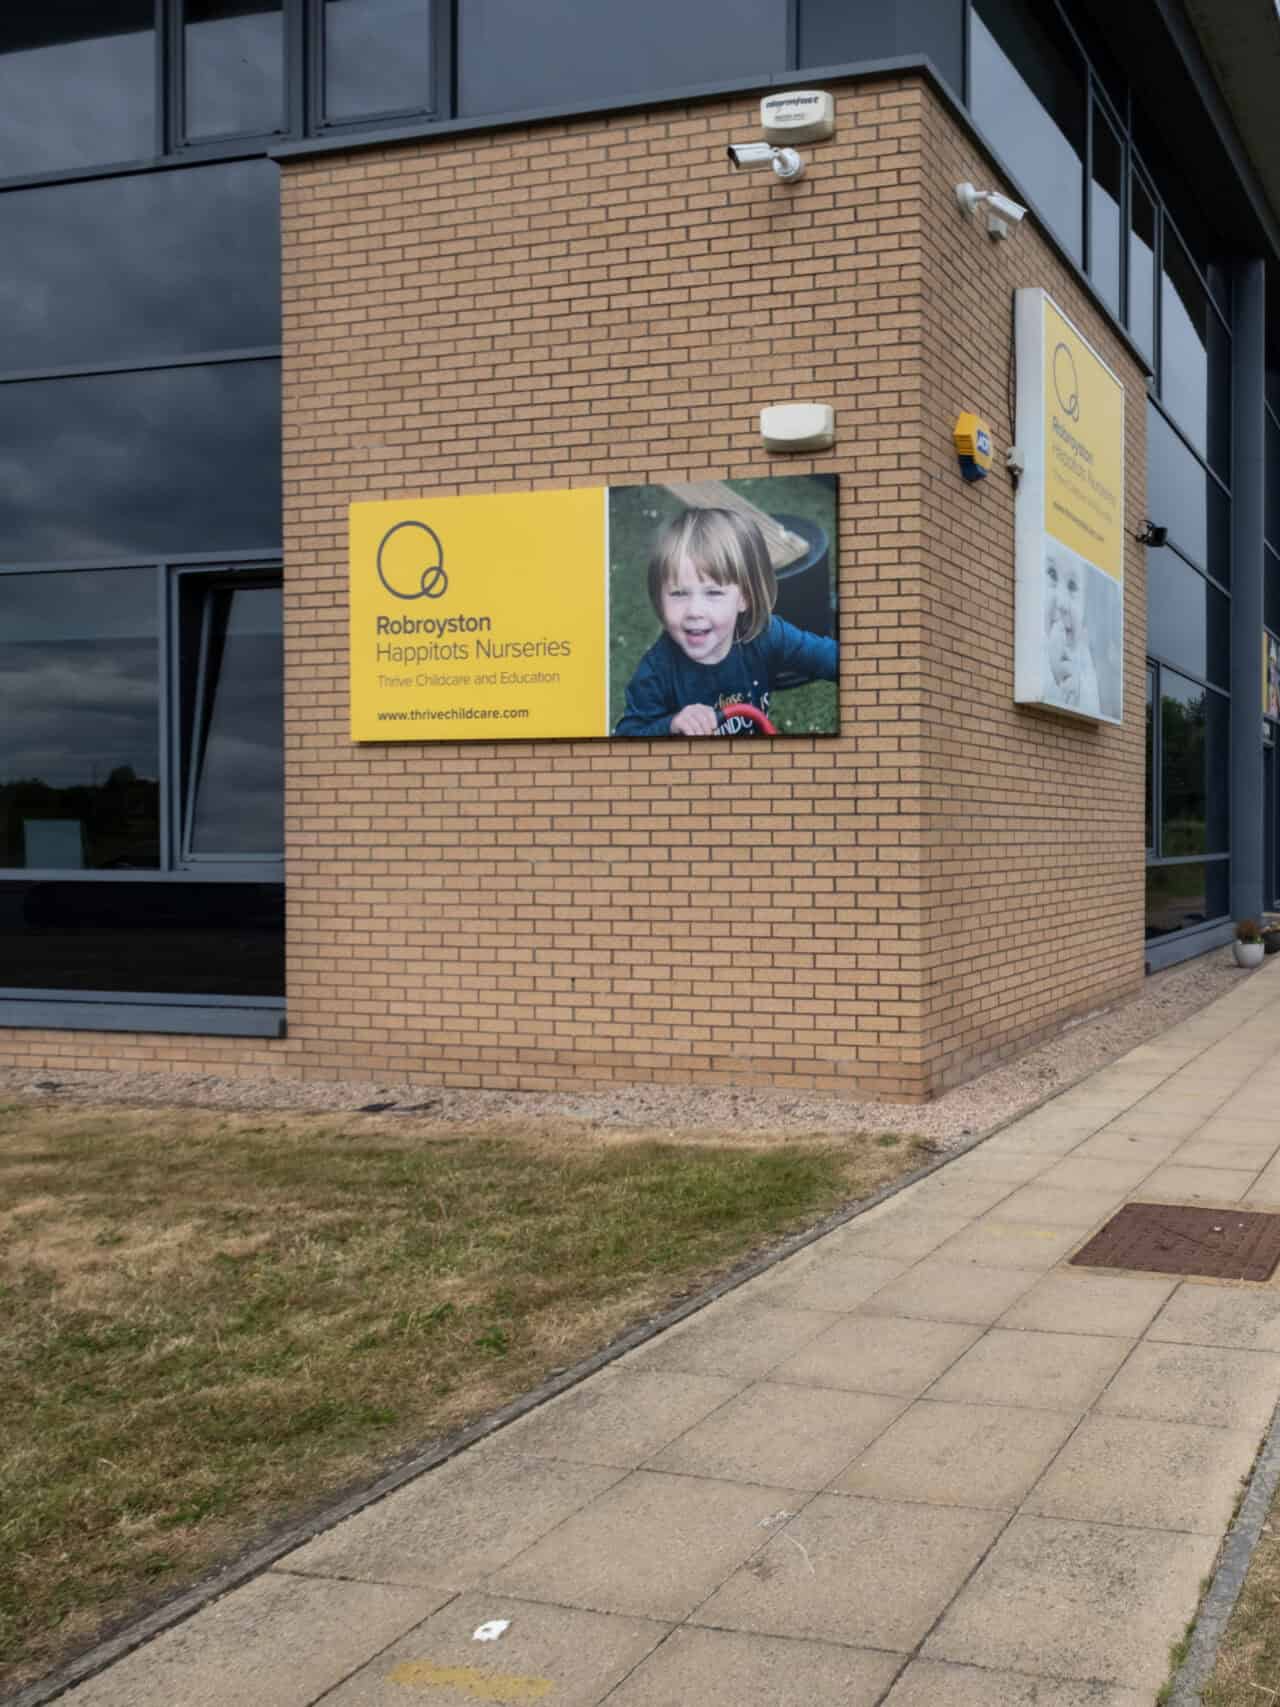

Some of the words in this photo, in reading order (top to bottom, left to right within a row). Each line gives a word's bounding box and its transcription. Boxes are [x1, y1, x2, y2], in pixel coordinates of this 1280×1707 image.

[376, 614, 492, 638] Robroyston
[376, 641, 469, 666] Happitots
[475, 637, 571, 659] Nurseries
[378, 674, 412, 687] Thrive
[416, 673, 471, 686] Childcare
[474, 672, 497, 684] and
[500, 671, 560, 684] Education
[377, 708, 529, 720] www.thrivechildcare.com
